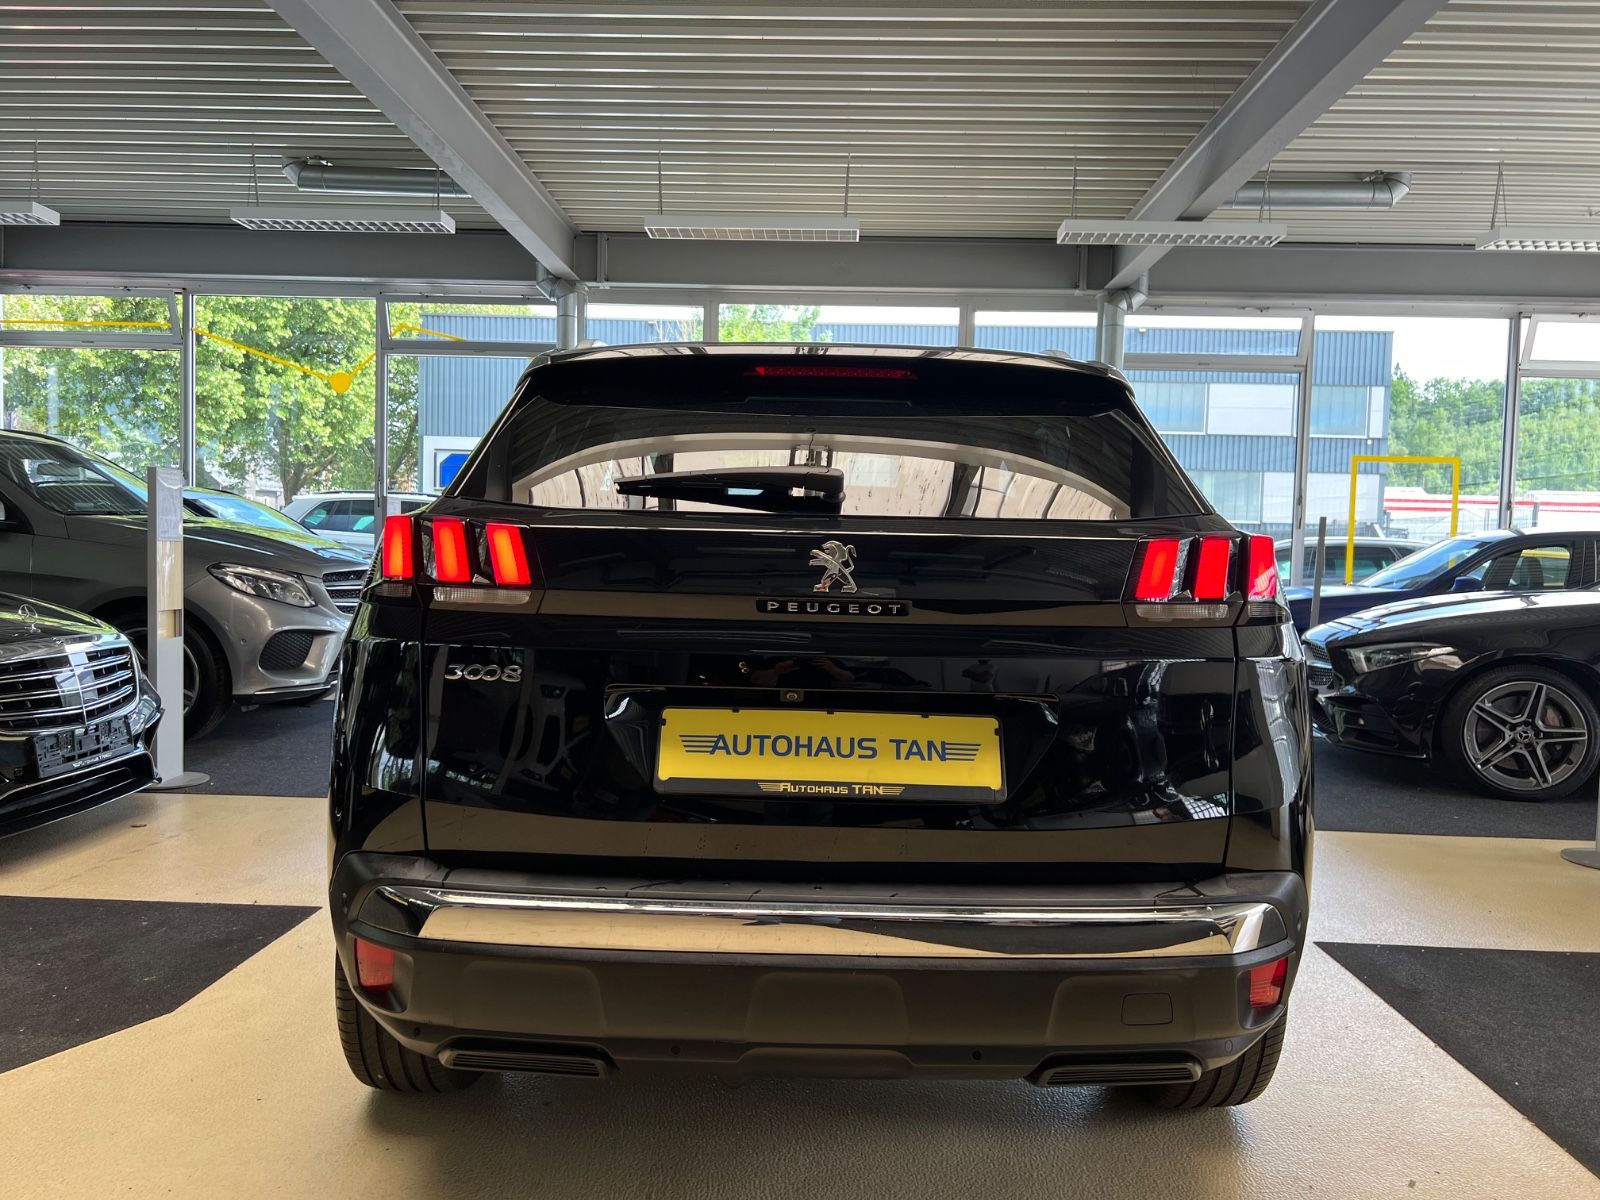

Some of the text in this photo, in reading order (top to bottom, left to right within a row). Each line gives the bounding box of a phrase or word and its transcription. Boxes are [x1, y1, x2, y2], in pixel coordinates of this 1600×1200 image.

[767, 601, 901, 614] PEUGEOT
[444, 664, 522, 682] 3008
[710, 734, 946, 762] AUTOHAUS TAN
[780, 782, 884, 795] AUTOHAUS TAN
